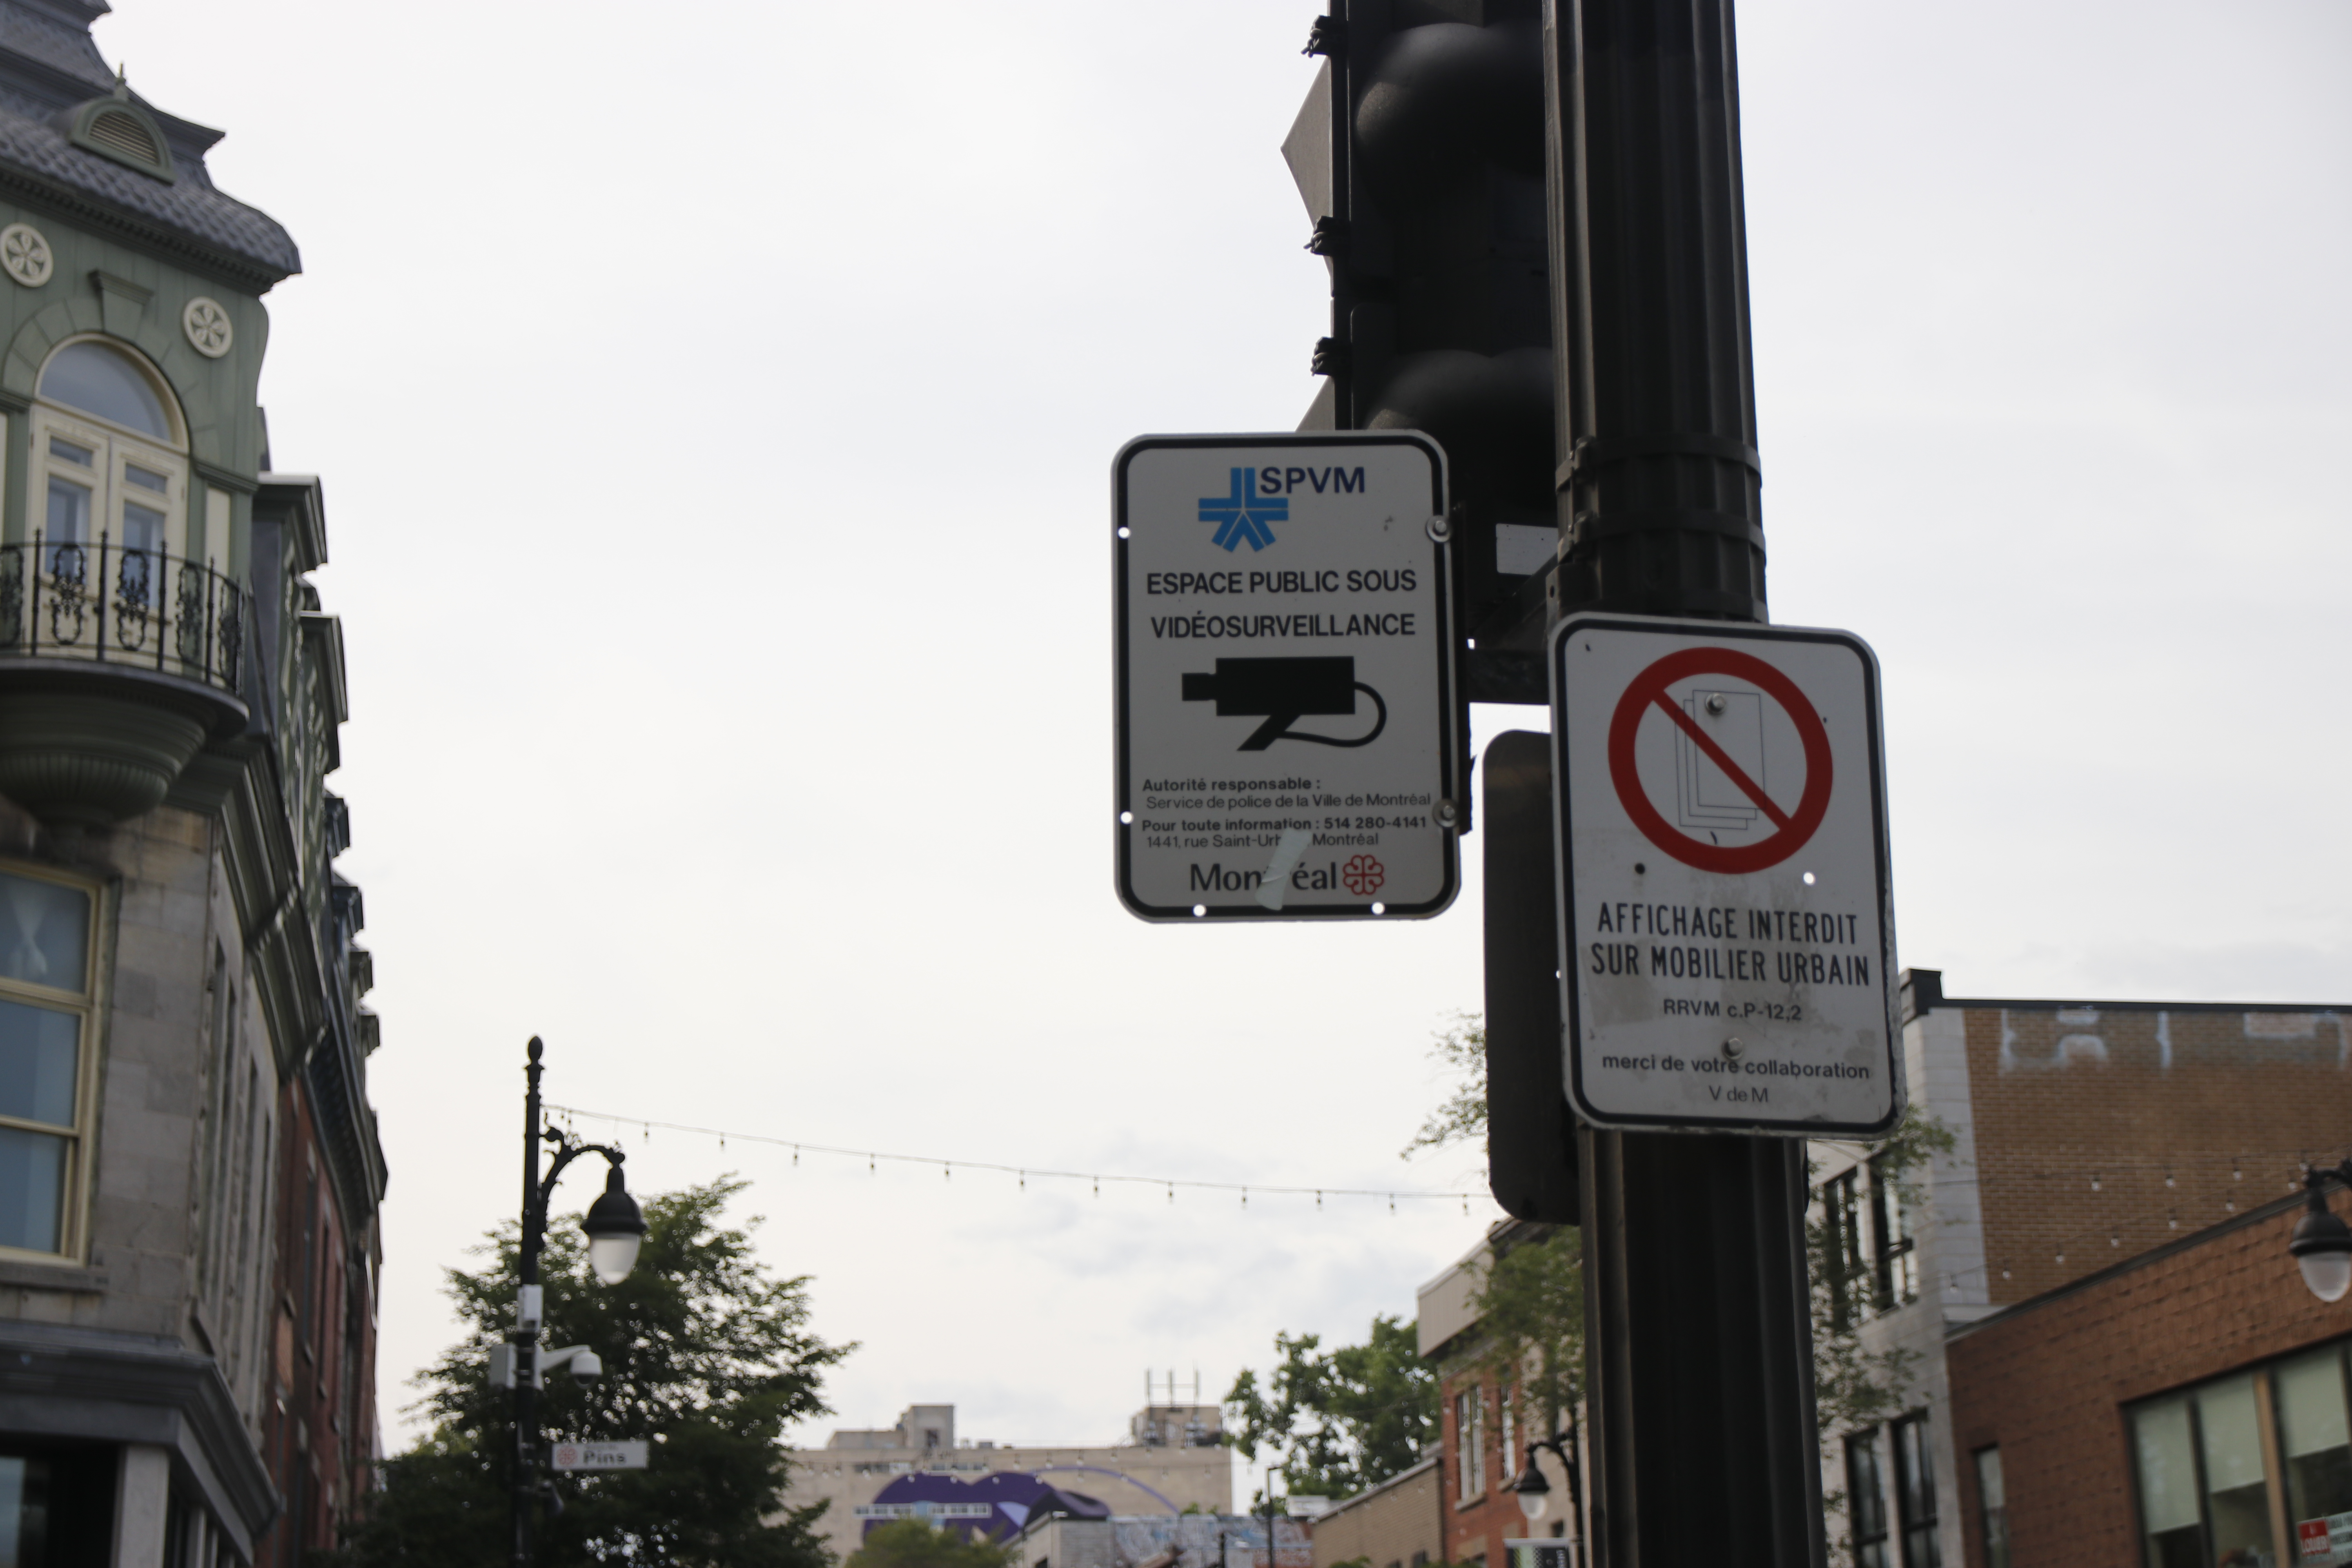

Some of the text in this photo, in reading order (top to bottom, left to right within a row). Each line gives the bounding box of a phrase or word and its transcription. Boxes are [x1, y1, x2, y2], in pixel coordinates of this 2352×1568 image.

[1260, 466, 1365, 494] SPVM
[1147, 569, 1417, 594] ESPACE PUBLIC SOUS
[1151, 610, 1416, 638] VIDÉOSURVEILLANCE
[1142, 778, 1207, 791] Autorité
[1147, 793, 1431, 811] Service de police de la Ville de Montréal
[1142, 820, 1176, 831] Pour
[1181, 819, 1221, 831] toute
[1325, 817, 1350, 829] 514
[1356, 816, 1426, 829] 280-4141
[1147, 833, 1378, 848] 1441, rue Saint-Urb, Montréal
[1191, 862, 1337, 891] Monéal
[1598, 902, 1857, 944] AFFICHAGE INTERDIT
[1591, 943, 1869, 987] SUR MOBILIER URBAIN
[1664, 999, 1720, 1016] RRVM
[1602, 1054, 1869, 1079] merci de votre collaboration
[1709, 1085, 1768, 1103] V de M
[583, 1450, 627, 1464] Pins
